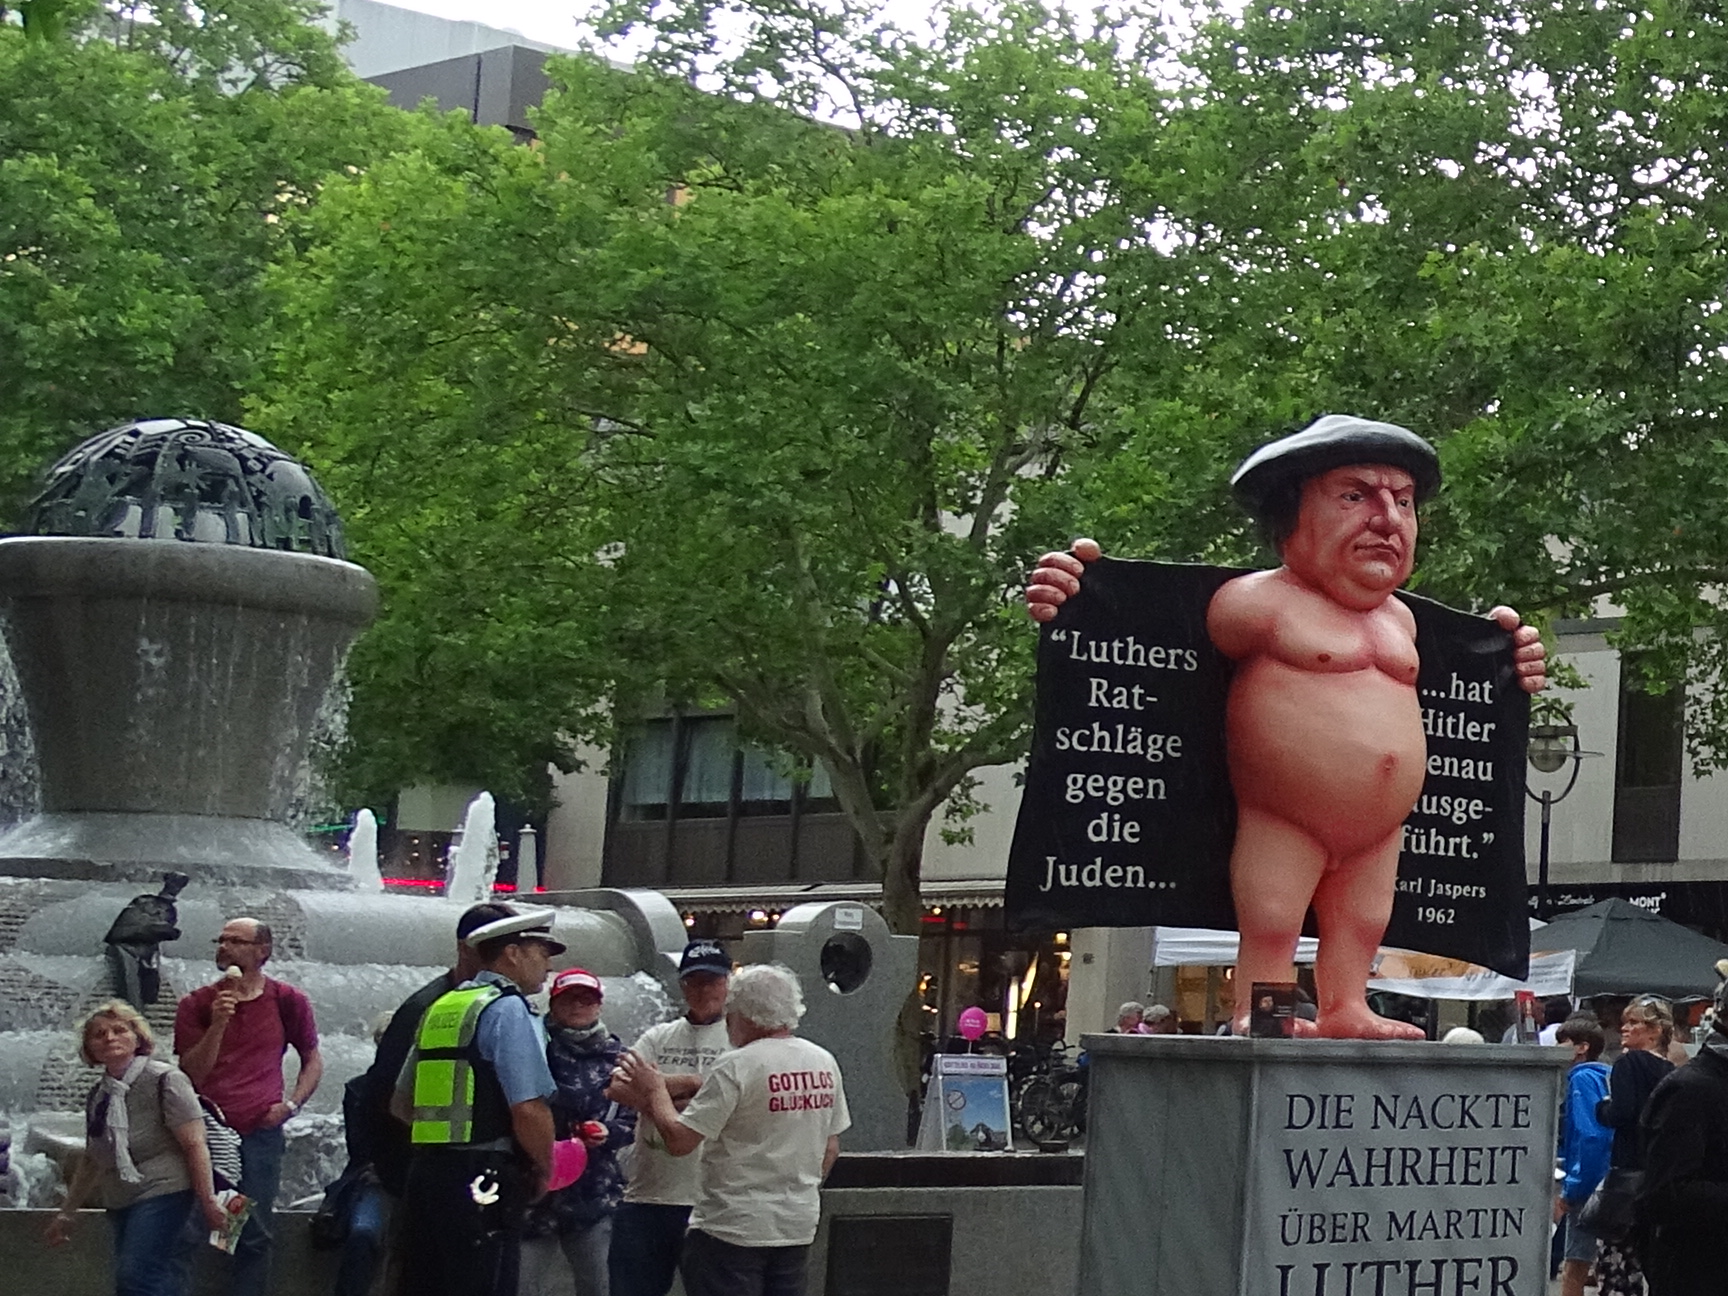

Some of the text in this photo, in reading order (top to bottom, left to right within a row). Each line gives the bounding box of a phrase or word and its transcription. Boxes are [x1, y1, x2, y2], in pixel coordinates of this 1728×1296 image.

[1050, 628, 1198, 672] “Luthers
[1087, 677, 1158, 711] Rat-
[1421, 671, 1494, 705] ...hat
[1055, 721, 1182, 763] schläge
[1426, 754, 1494, 782] enau
[1065, 773, 1167, 806] gegen
[1087, 811, 1141, 844] die
[1039, 855, 1177, 892] Juden...
[1427, 878, 1488, 900] Jaspers
[1416, 906, 1456, 925] 1962
[768, 1071, 834, 1093] GOTTLOS
[1283, 1093, 1531, 1131] DIE NACKTE
[1281, 1145, 1529, 1190] WAHRHEIT
[1279, 1207, 1526, 1247] ÜBER MARTIN
